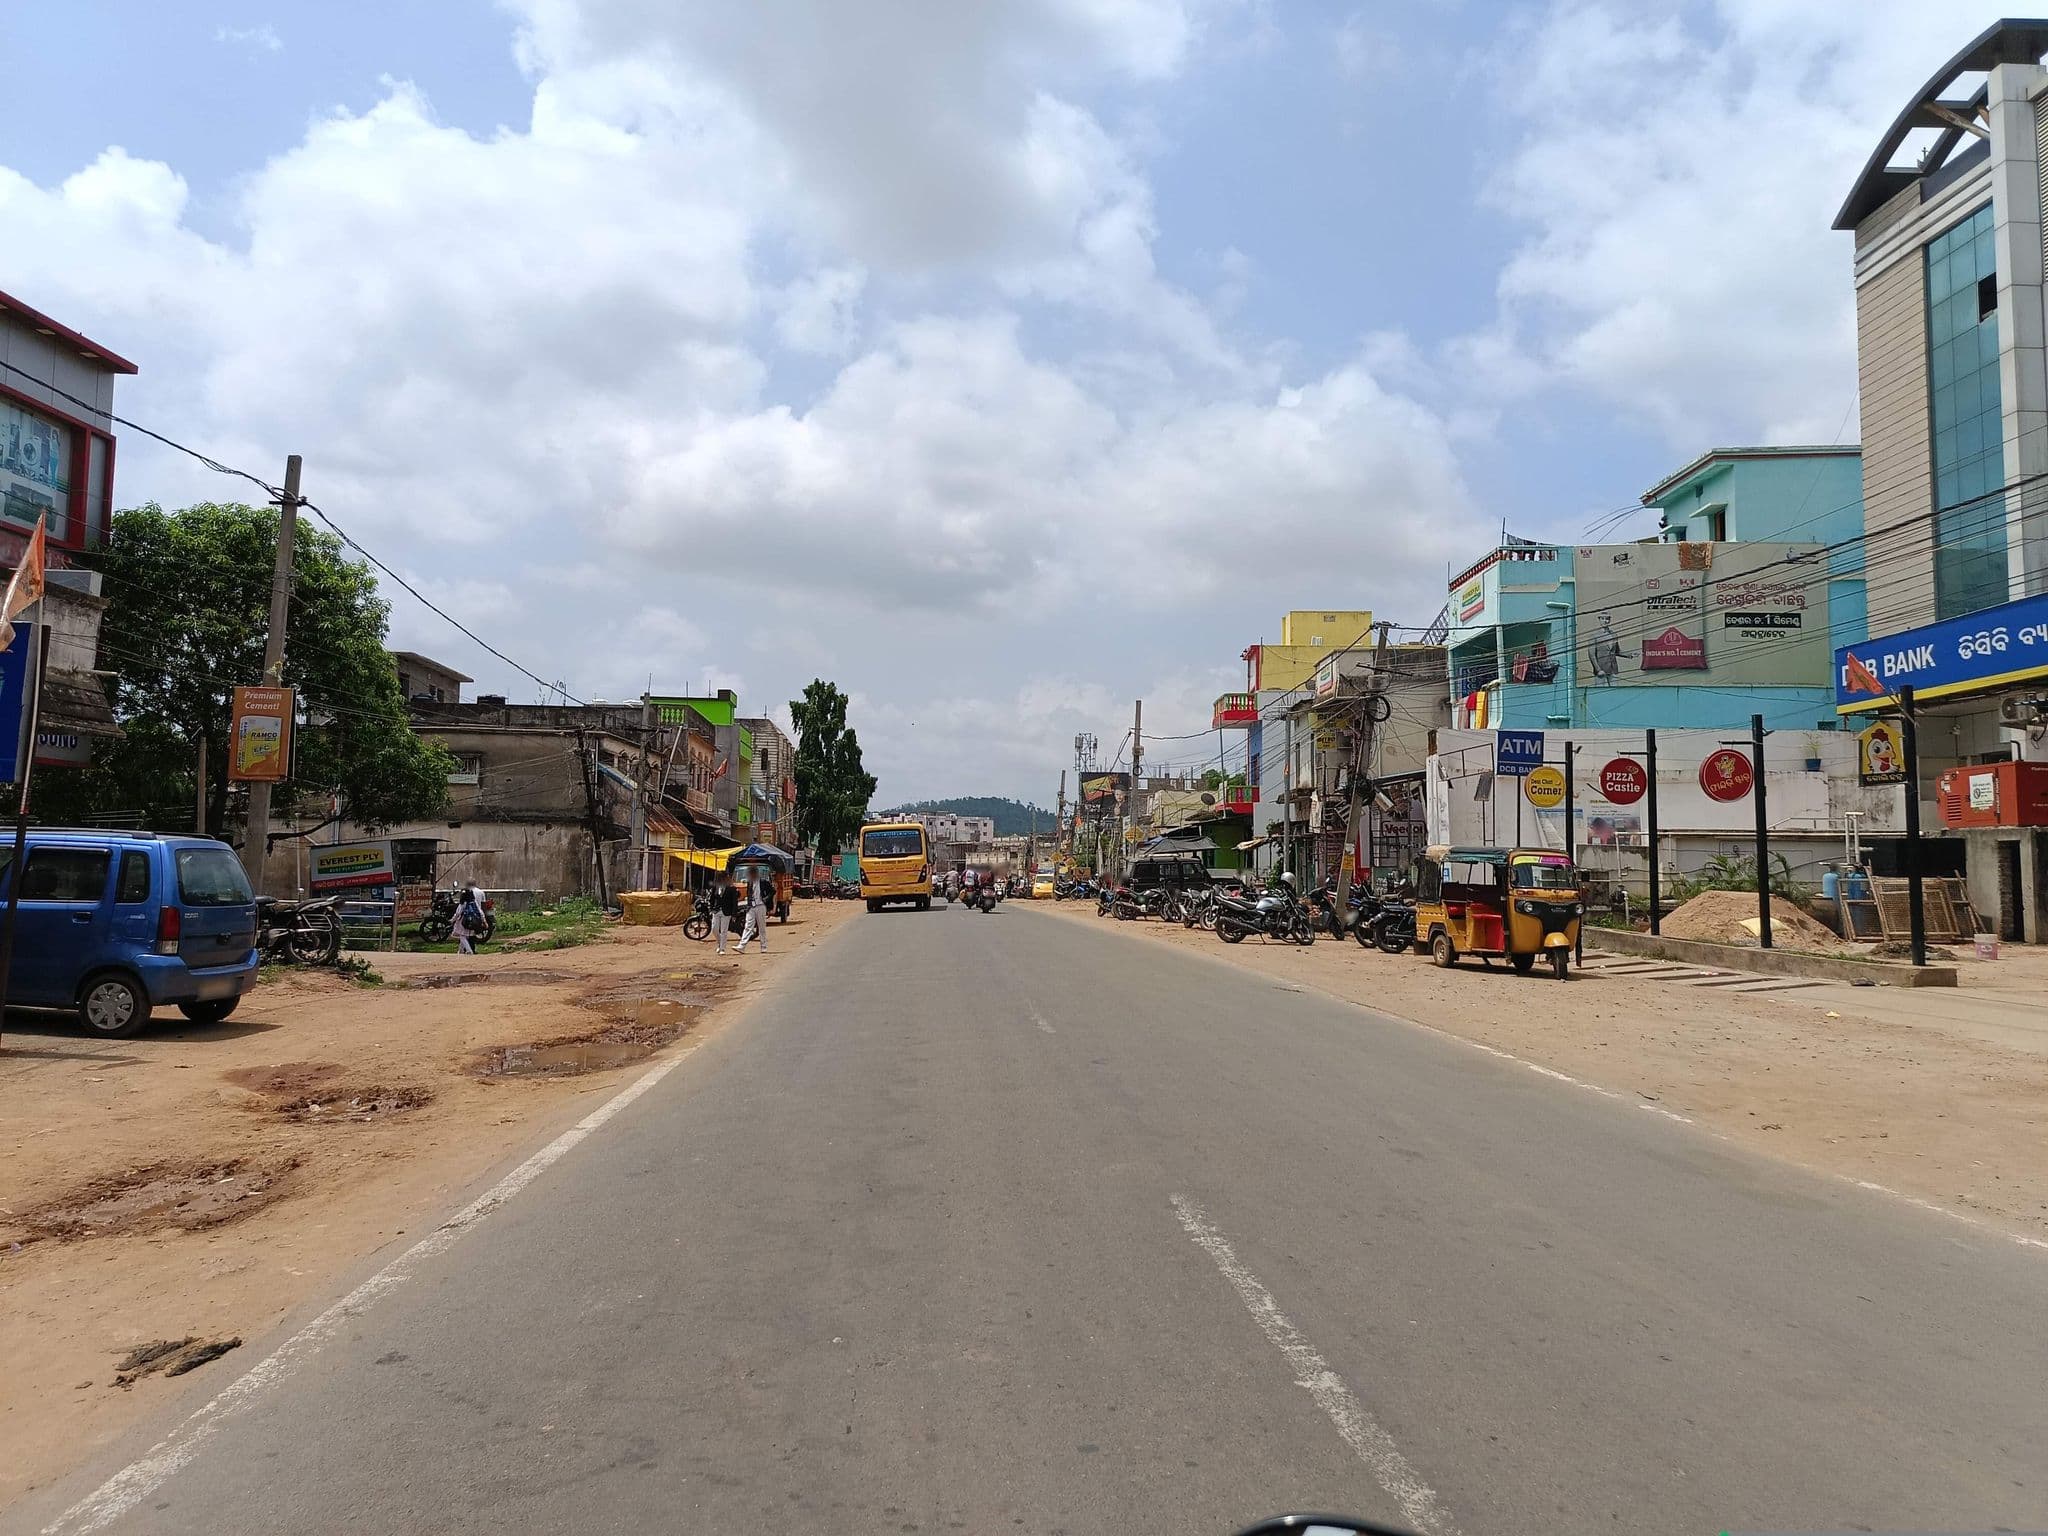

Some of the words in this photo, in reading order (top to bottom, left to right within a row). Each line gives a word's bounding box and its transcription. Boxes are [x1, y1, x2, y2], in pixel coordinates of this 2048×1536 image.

[1883, 644, 1936, 677] BANK
[244, 691, 282, 700] Premium
[1500, 738, 1541, 755] ATM
[1499, 765, 1516, 773] DCB
[1606, 772, 1634, 782] PIZZA
[1531, 786, 1562, 796] Corner
[1606, 783, 1641, 793] Castle
[320, 854, 360, 866] EVEREST
[362, 852, 380, 862] PLY
